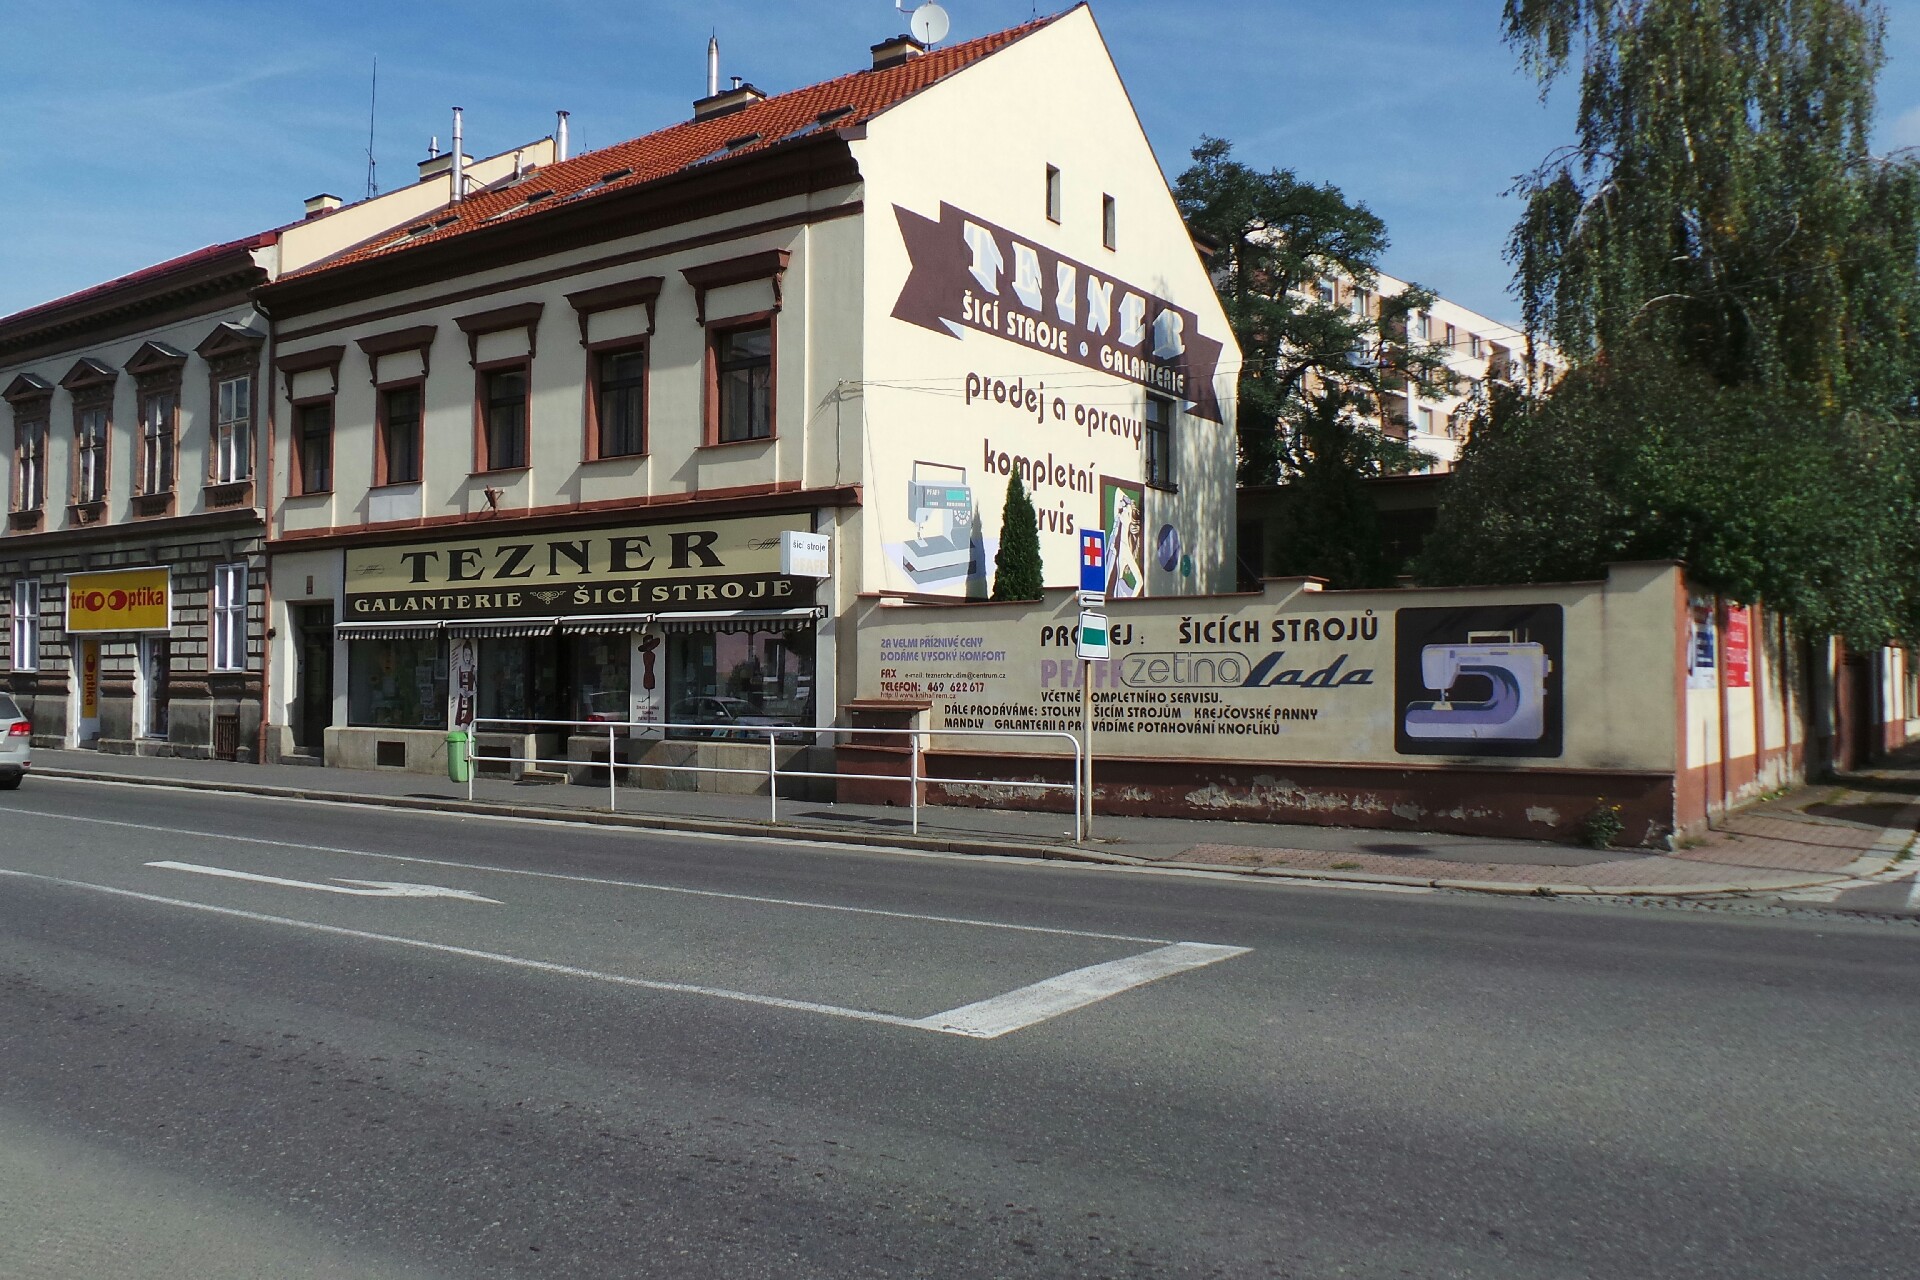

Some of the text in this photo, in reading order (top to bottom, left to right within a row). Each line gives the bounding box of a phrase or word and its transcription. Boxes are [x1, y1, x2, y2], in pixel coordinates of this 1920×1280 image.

[963, 219, 1185, 360] TEZNER
[962, 290, 1184, 394] ŠICÍ STROJE GALANTERIE
[966, 372, 1142, 450] prodej a opravy
[984, 438, 1096, 494] kompletní
[1038, 500, 1074, 536] rvis
[400, 530, 725, 584] TEZNER
[354, 580, 793, 613] GALANTERIE ŠICÍ STROJE
[893, 637, 918, 648] VELMI
[919, 635, 959, 648] PŘÍZNIVÉ
[960, 637, 983, 648] CENY
[1041, 624, 1132, 646] PREJ
[1179, 615, 1260, 644] ŠICÍCH
[1272, 609, 1378, 642] STROJŮ
[880, 649, 1006, 661] DODÁME VYSOKÝ KOMFORT
[1129, 652, 1241, 683] zetina
[880, 669, 897, 678] FAX
[880, 682, 985, 693] TELEFON: 469 622 617
[944, 702, 1318, 720] DÁLE PRODÁVÁME: STOLKY ŠICÍM STROJŮM KREJČOVSKÉ PANNY
[1041, 690, 1223, 703] VČETNĚ OMPLETNÍHO SERVISU.
[944, 718, 984, 729] MANDLY
[994, 719, 1056, 731] GALANTERII
[1058, 720, 1066, 731] A
[1137, 720, 1215, 734] POTAHOVÁNÍ
[1218, 719, 1280, 735] KNOFLÍKŮ
